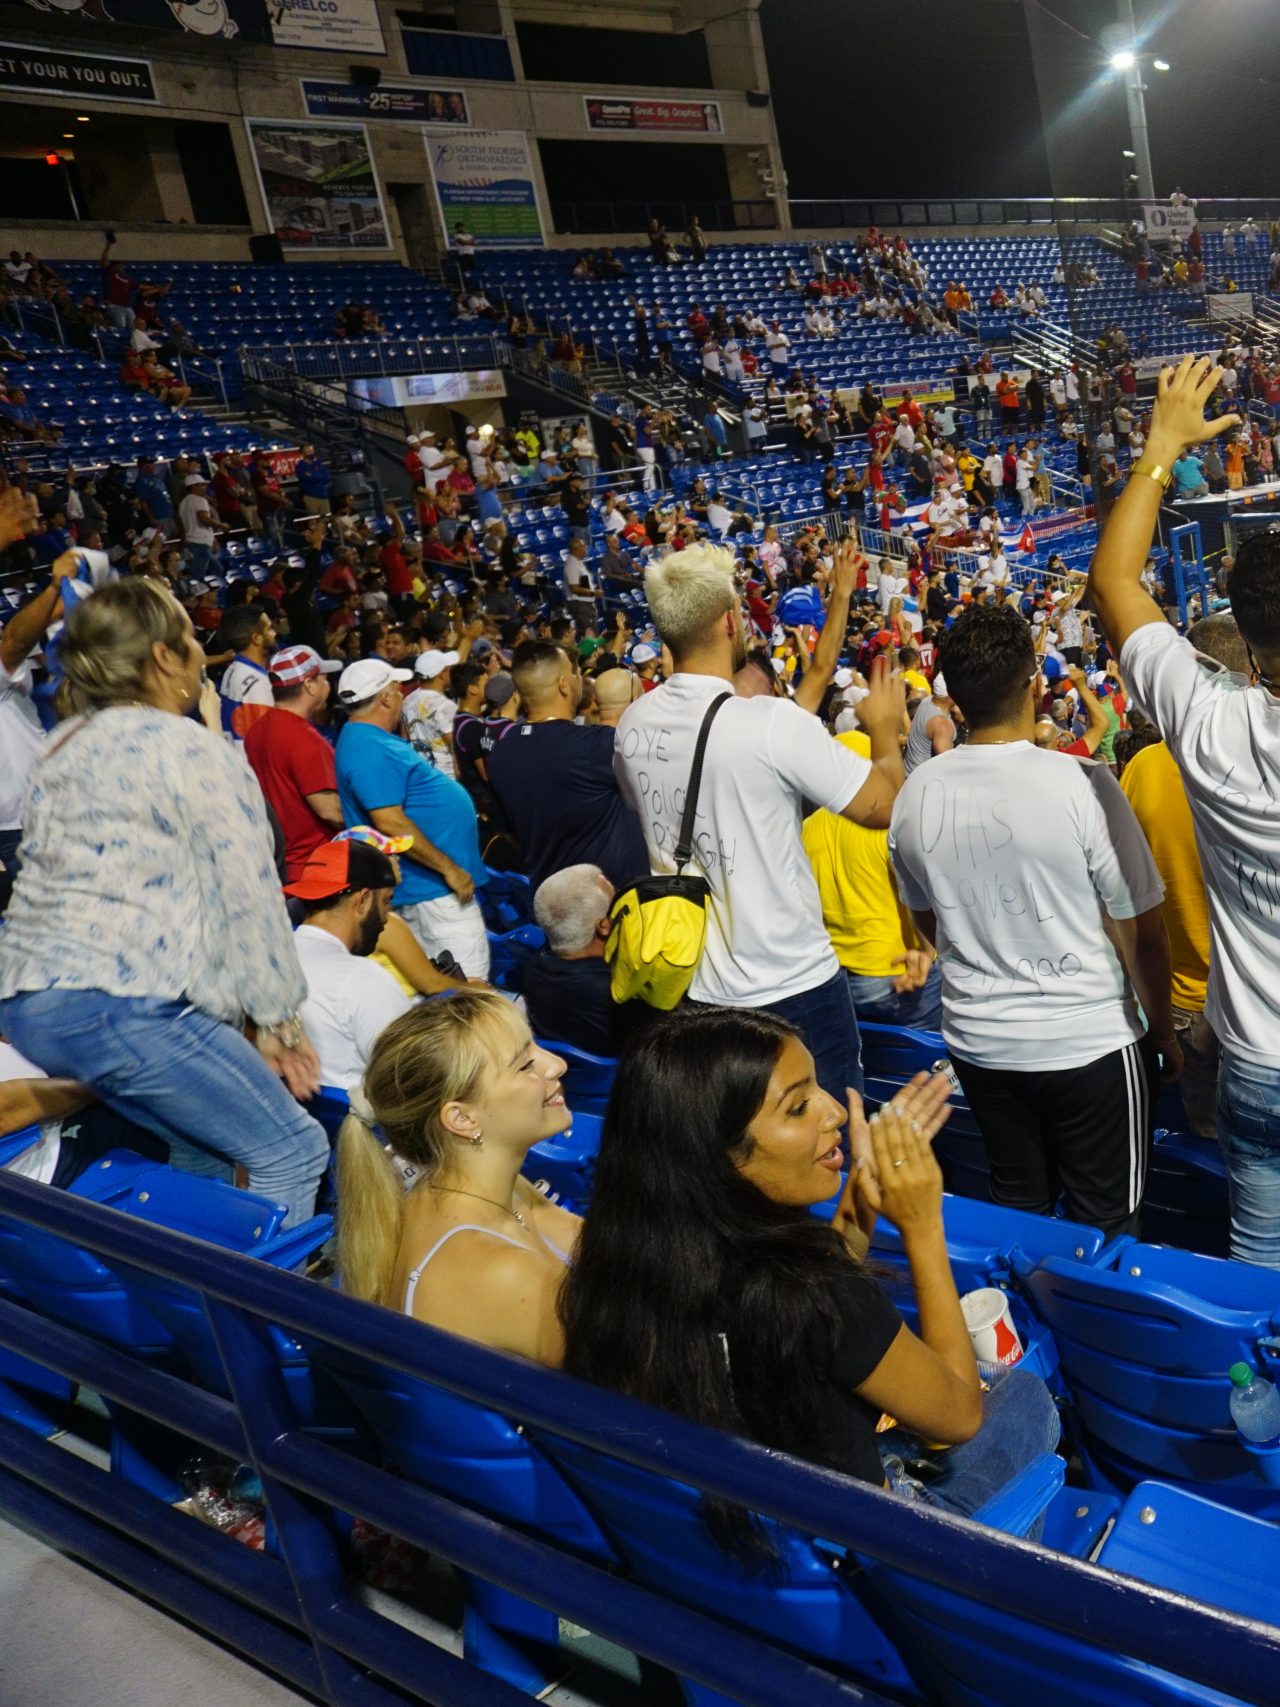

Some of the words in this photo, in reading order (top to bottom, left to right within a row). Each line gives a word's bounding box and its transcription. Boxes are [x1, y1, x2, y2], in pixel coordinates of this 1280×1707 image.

[21, 60, 69, 80] YOUR
[72, 67, 106, 84] YOU
[110, 71, 147, 88] OUT.
[369, 92, 390, 110] 25
[455, 144, 487, 155] SOUTH
[488, 146, 525, 156] FLORIDA
[920, 649, 932, 667] 17
[622, 727, 671, 763] OYE
[919, 777, 1013, 869] DIAS
